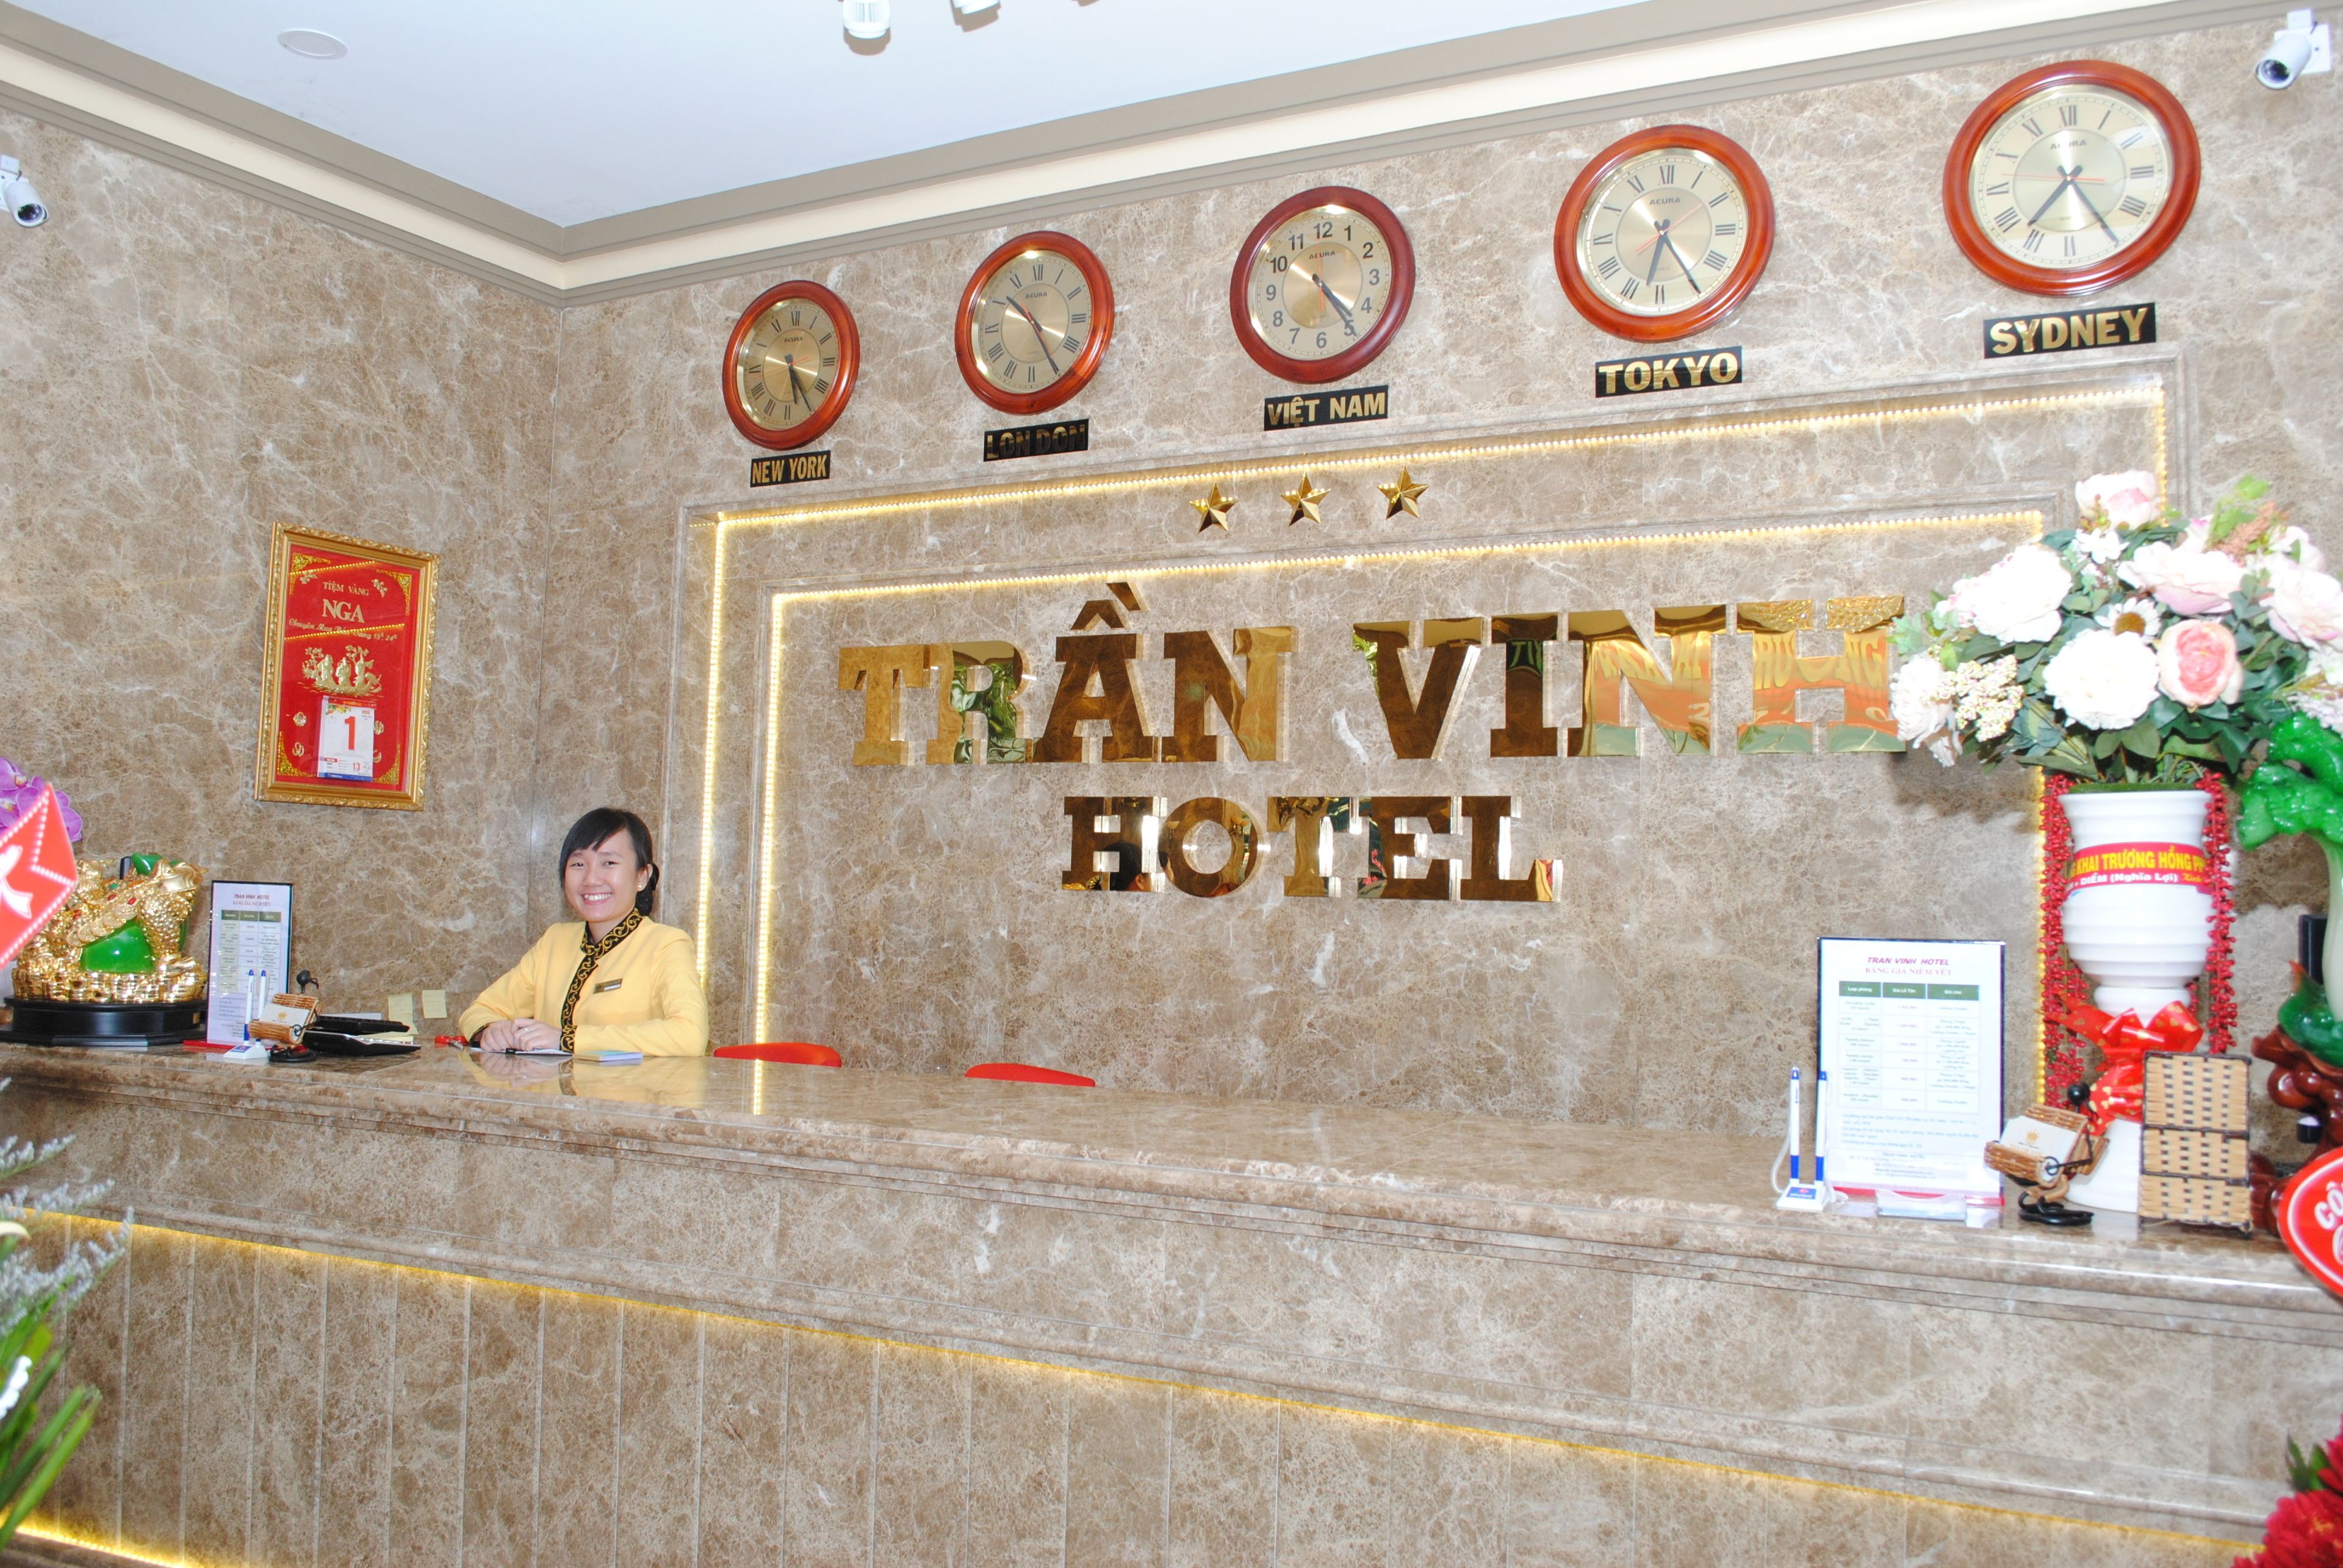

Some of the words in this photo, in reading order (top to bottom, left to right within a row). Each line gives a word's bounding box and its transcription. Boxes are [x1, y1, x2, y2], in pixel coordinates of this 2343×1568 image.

[2050, 140, 2087, 149] ACRA
[1314, 221, 1333, 239] 12
[1344, 225, 1351, 241] 1
[1289, 234, 1303, 250] 11
[1362, 242, 1373, 259] 2
[1309, 251, 1335, 259] ACURA
[1270, 256, 1287, 273] 10
[1369, 269, 1380, 285] 3
[1266, 285, 1276, 301] 9
[1361, 298, 1372, 313] 4
[1273, 311, 1283, 326] 8
[1289, 328, 1300, 344] 7
[1344, 320, 1354, 336] 5
[1990, 307, 2148, 354] SYDNEY
[1317, 332, 1326, 348] 6
[1599, 352, 1738, 394] TOKYO
[1267, 397, 1319, 426] VIỆT
[1330, 392, 1386, 420] NAM
[987, 424, 1085, 459] LONDON
[752, 460, 784, 484] NEW
[789, 455, 827, 480] YORK
[348, 583, 369, 595] VÀNG
[322, 599, 365, 623] NGA
[838, 582, 1295, 766] TRẦN
[1353, 595, 1907, 760] VINH
[344, 716, 355, 750] 1
[1062, 796, 1560, 902] HOTEL
[2076, 855, 2099, 876] KHAI
[2101, 849, 2155, 869] TRƯƠNG
